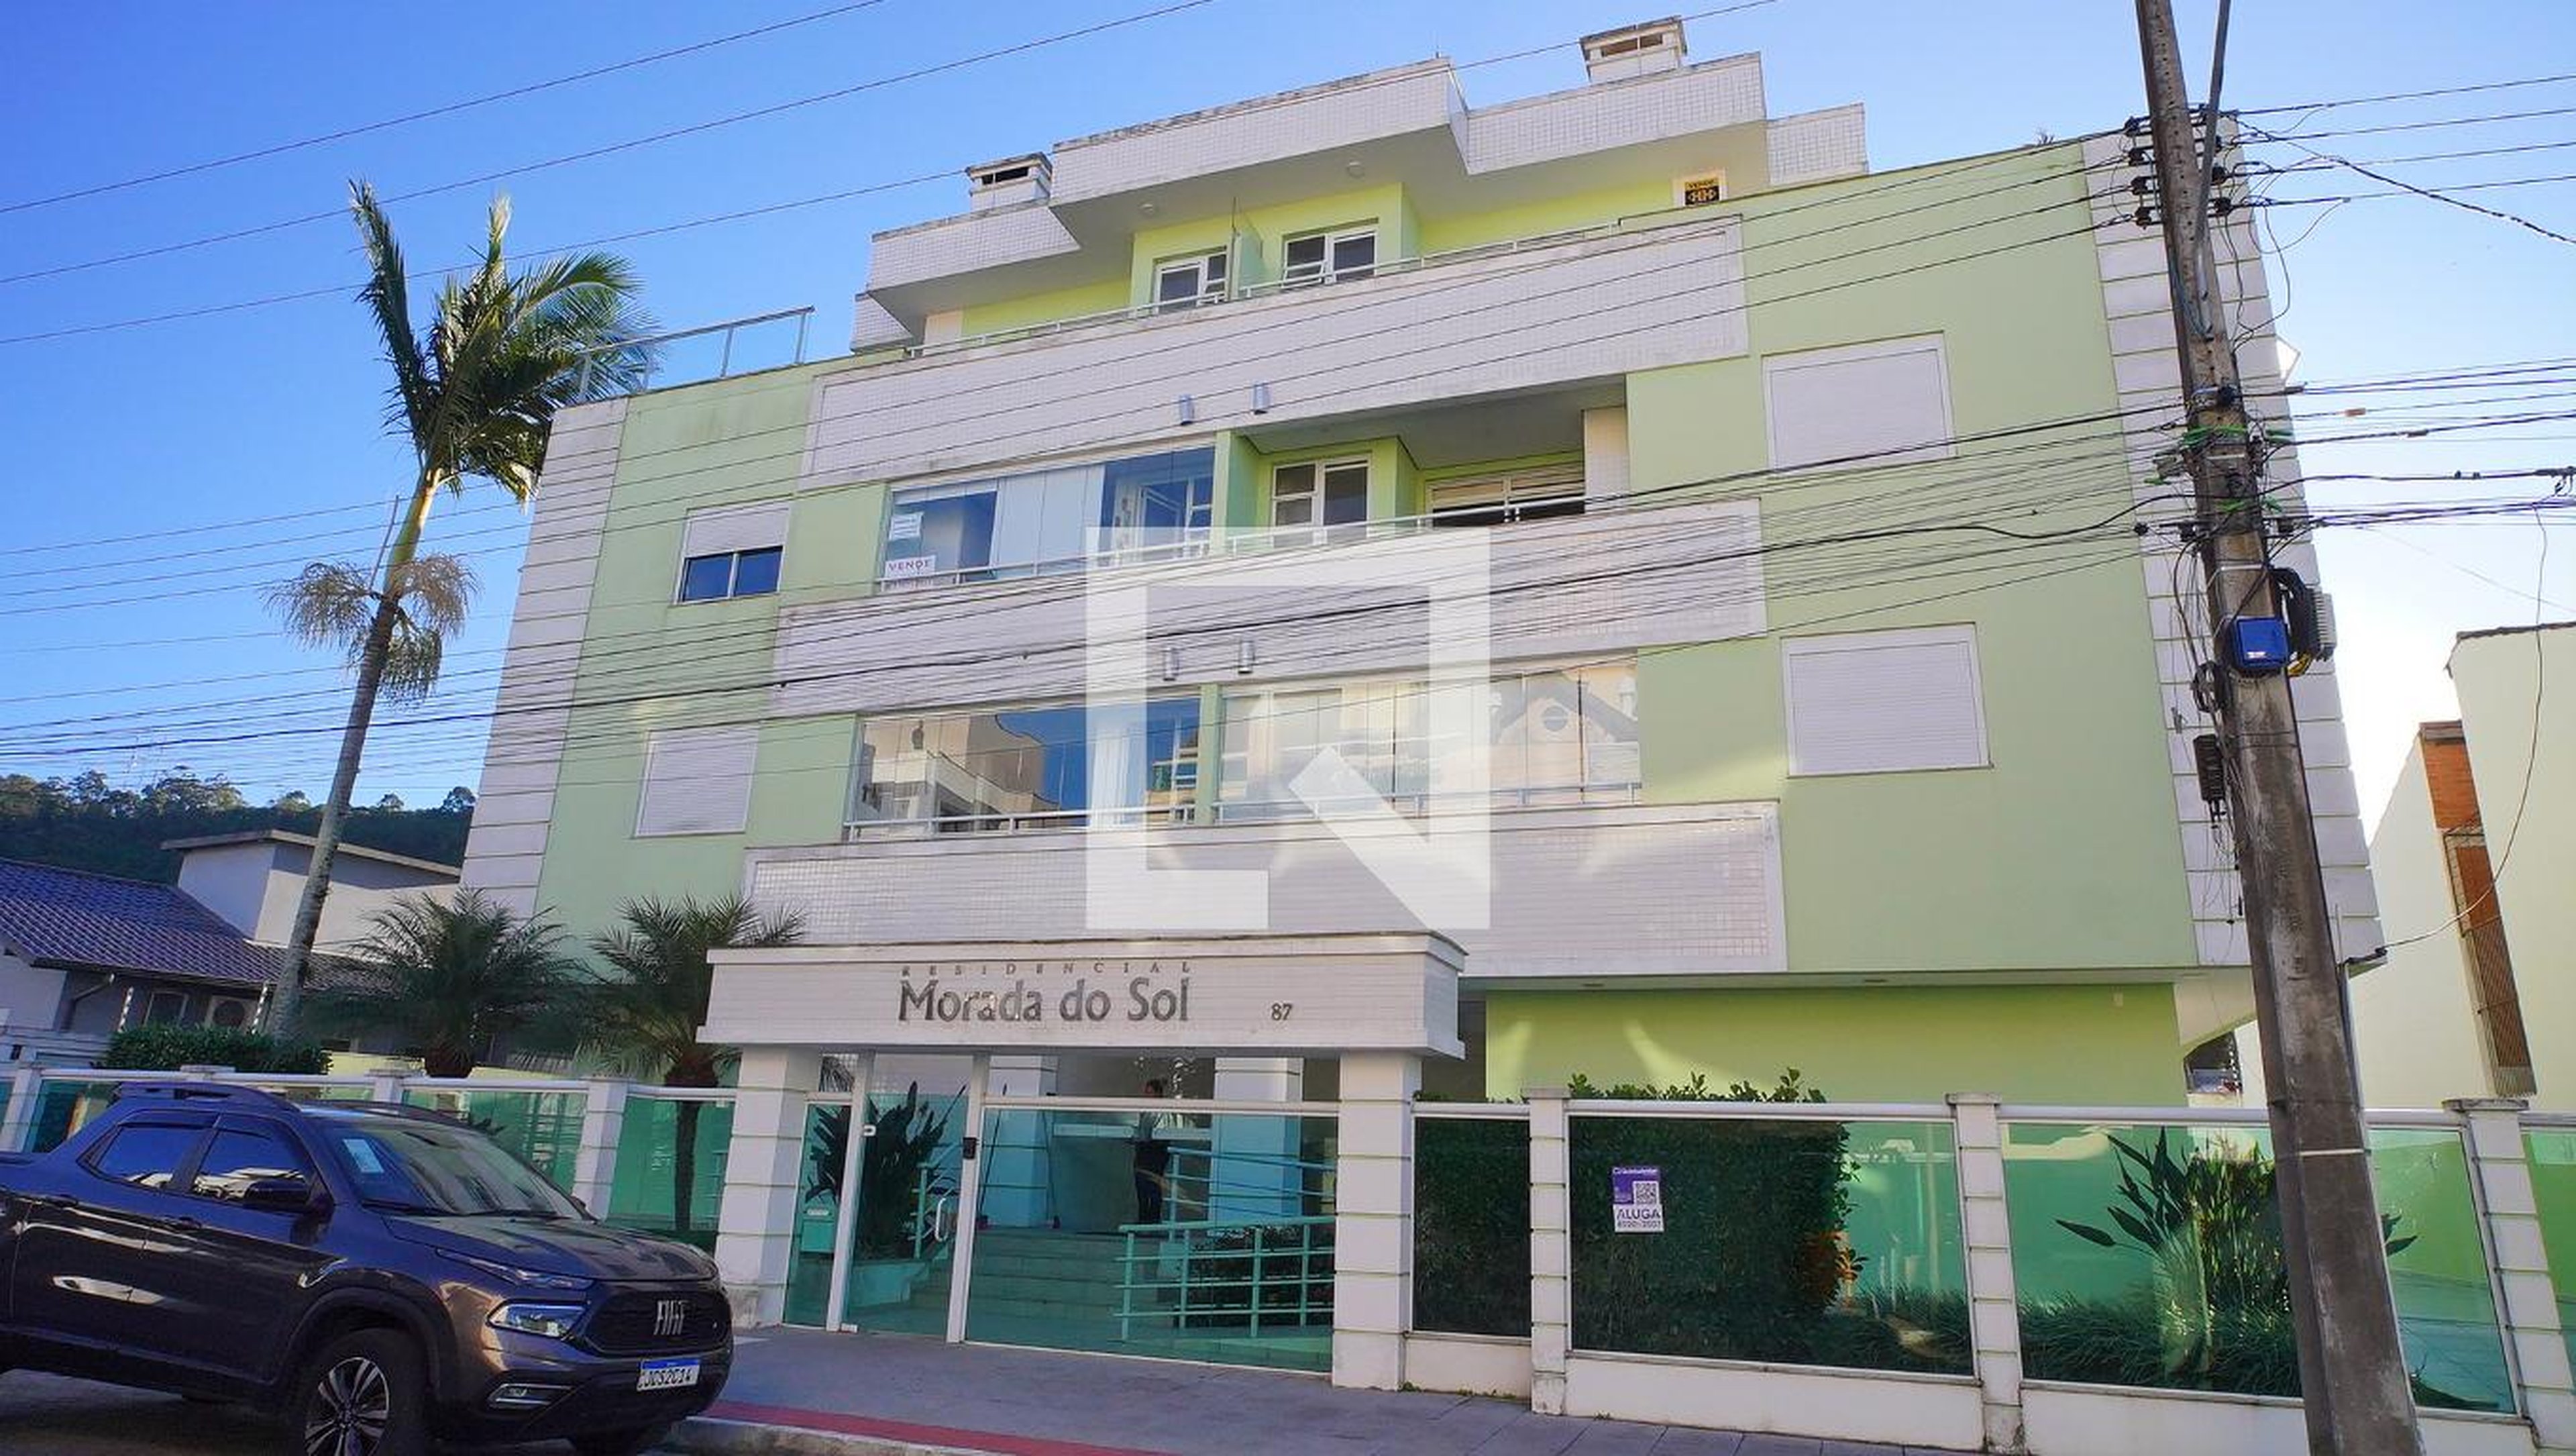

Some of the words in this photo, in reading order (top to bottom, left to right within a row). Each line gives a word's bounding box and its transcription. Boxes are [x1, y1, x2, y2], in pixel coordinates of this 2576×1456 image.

[902, 961, 1191, 976] RESIDENCIAL
[898, 978, 1042, 1022] Morada
[1059, 978, 1111, 1022] do
[1126, 976, 1189, 1022] Sol
[1271, 1003, 1293, 1021] 87
[1617, 1209, 1660, 1220] ALUGA
